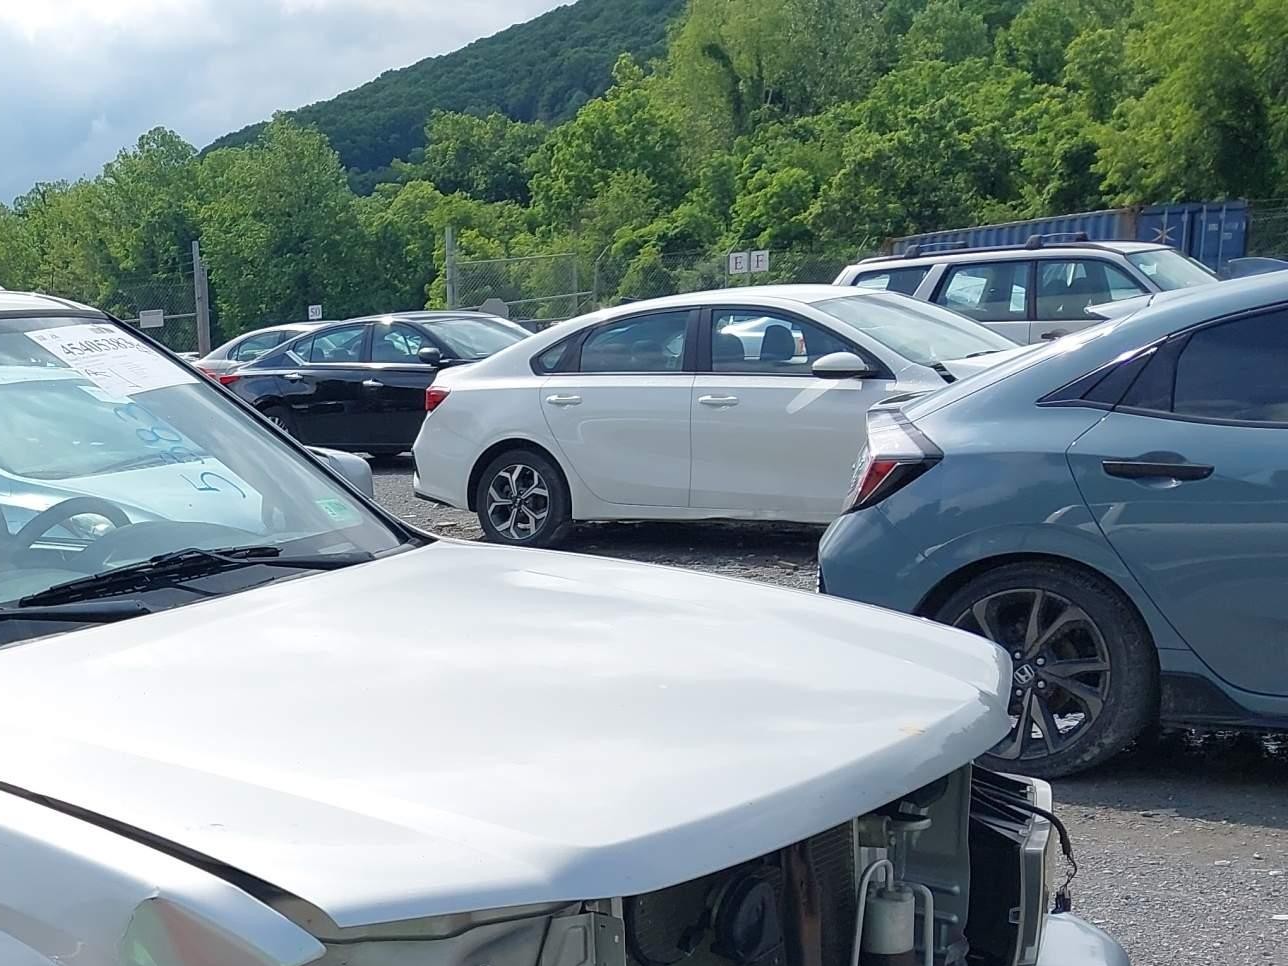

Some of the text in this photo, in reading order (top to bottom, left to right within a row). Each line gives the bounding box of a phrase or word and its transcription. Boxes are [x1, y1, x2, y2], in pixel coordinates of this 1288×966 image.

[734, 255, 744, 270] E
[755, 254, 765, 269] F
[310, 307, 321, 318] 50
[60, 337, 135, 357] 45405383
